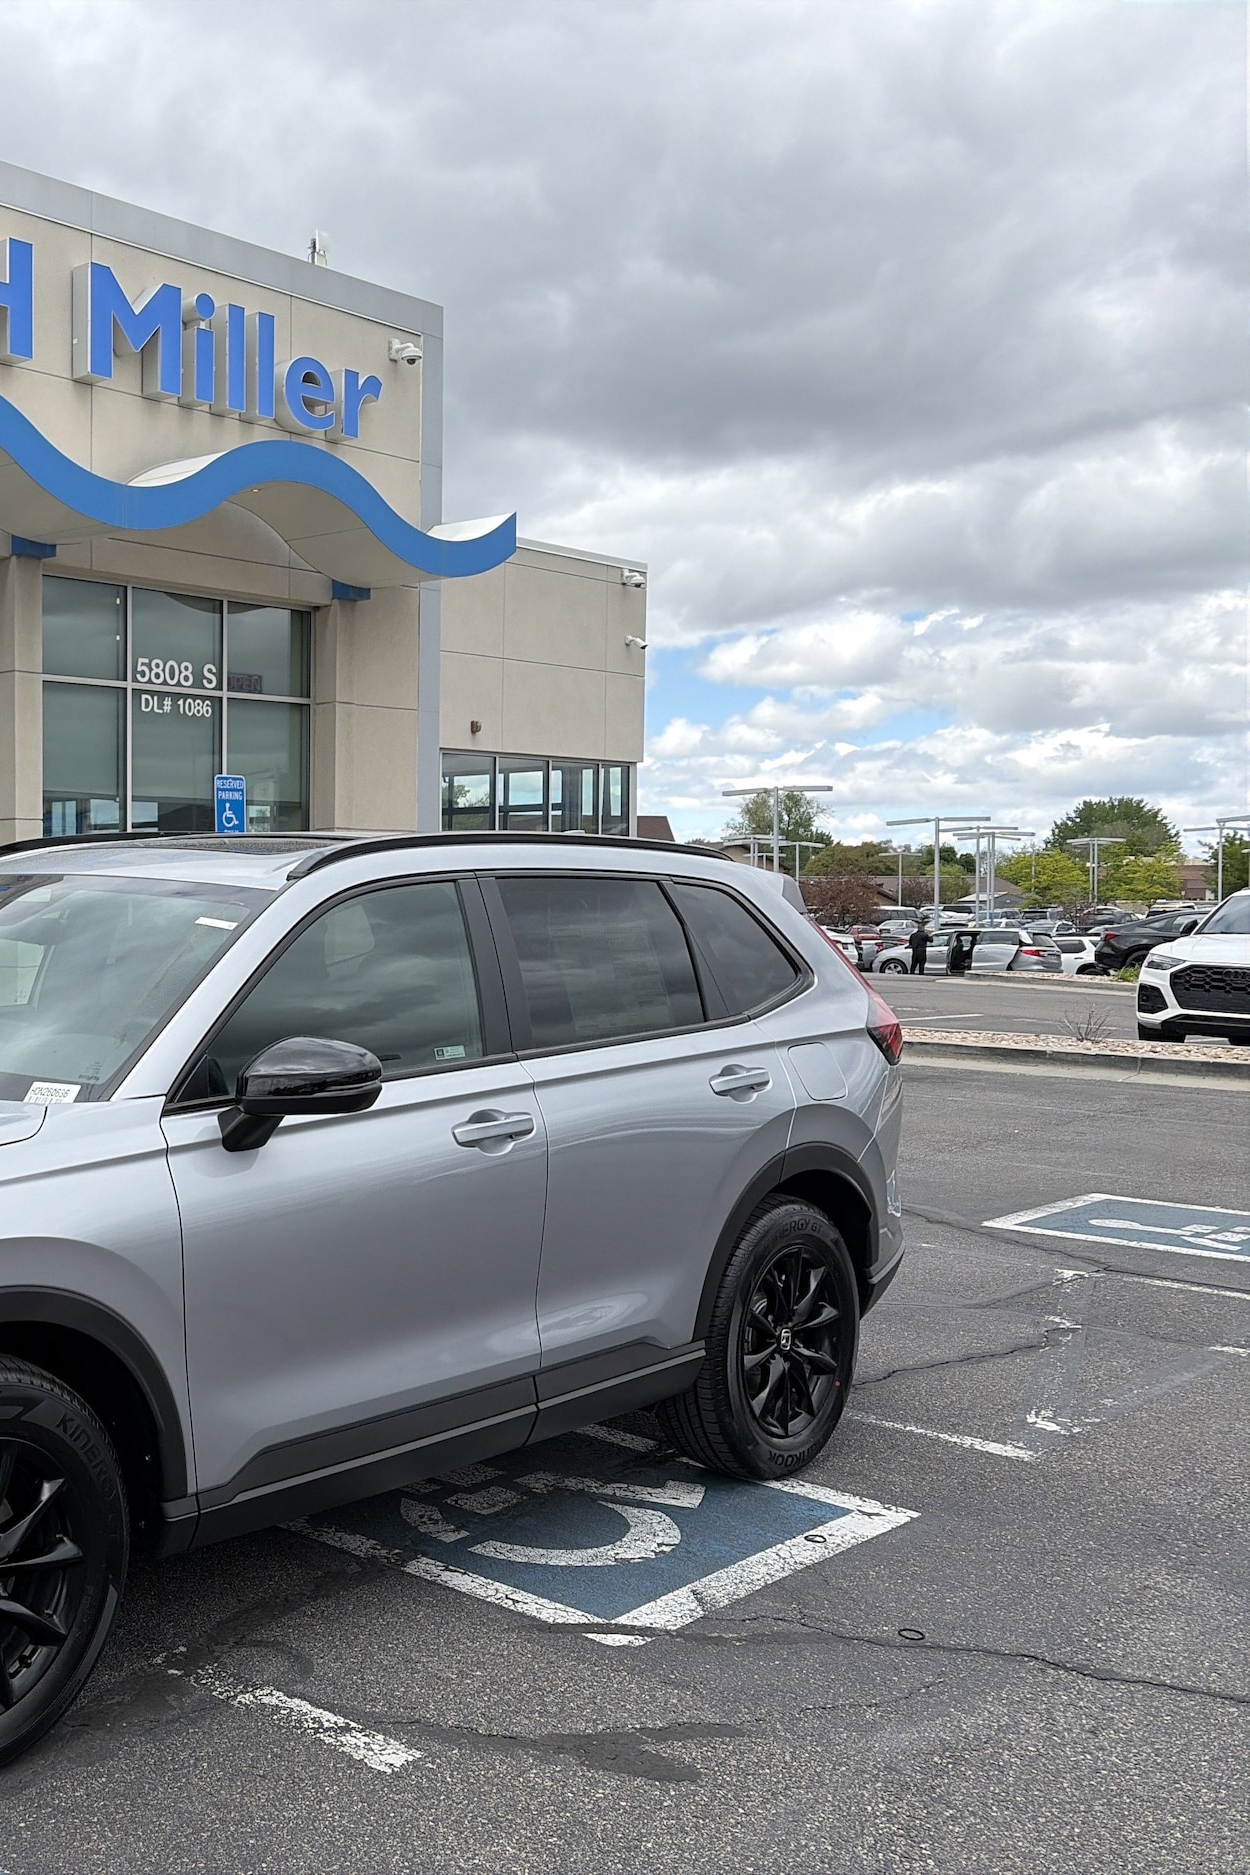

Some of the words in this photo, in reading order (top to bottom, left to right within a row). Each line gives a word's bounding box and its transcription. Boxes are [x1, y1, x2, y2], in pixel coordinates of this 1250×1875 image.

[73, 261, 383, 439] Miller
[136, 657, 193, 687] 5808
[202, 663, 217, 689] S
[141, 694, 172, 713] DL#
[177, 698, 212, 717] 1086
[217, 779, 243, 789] RESERVED
[218, 791, 242, 800] PARKING
